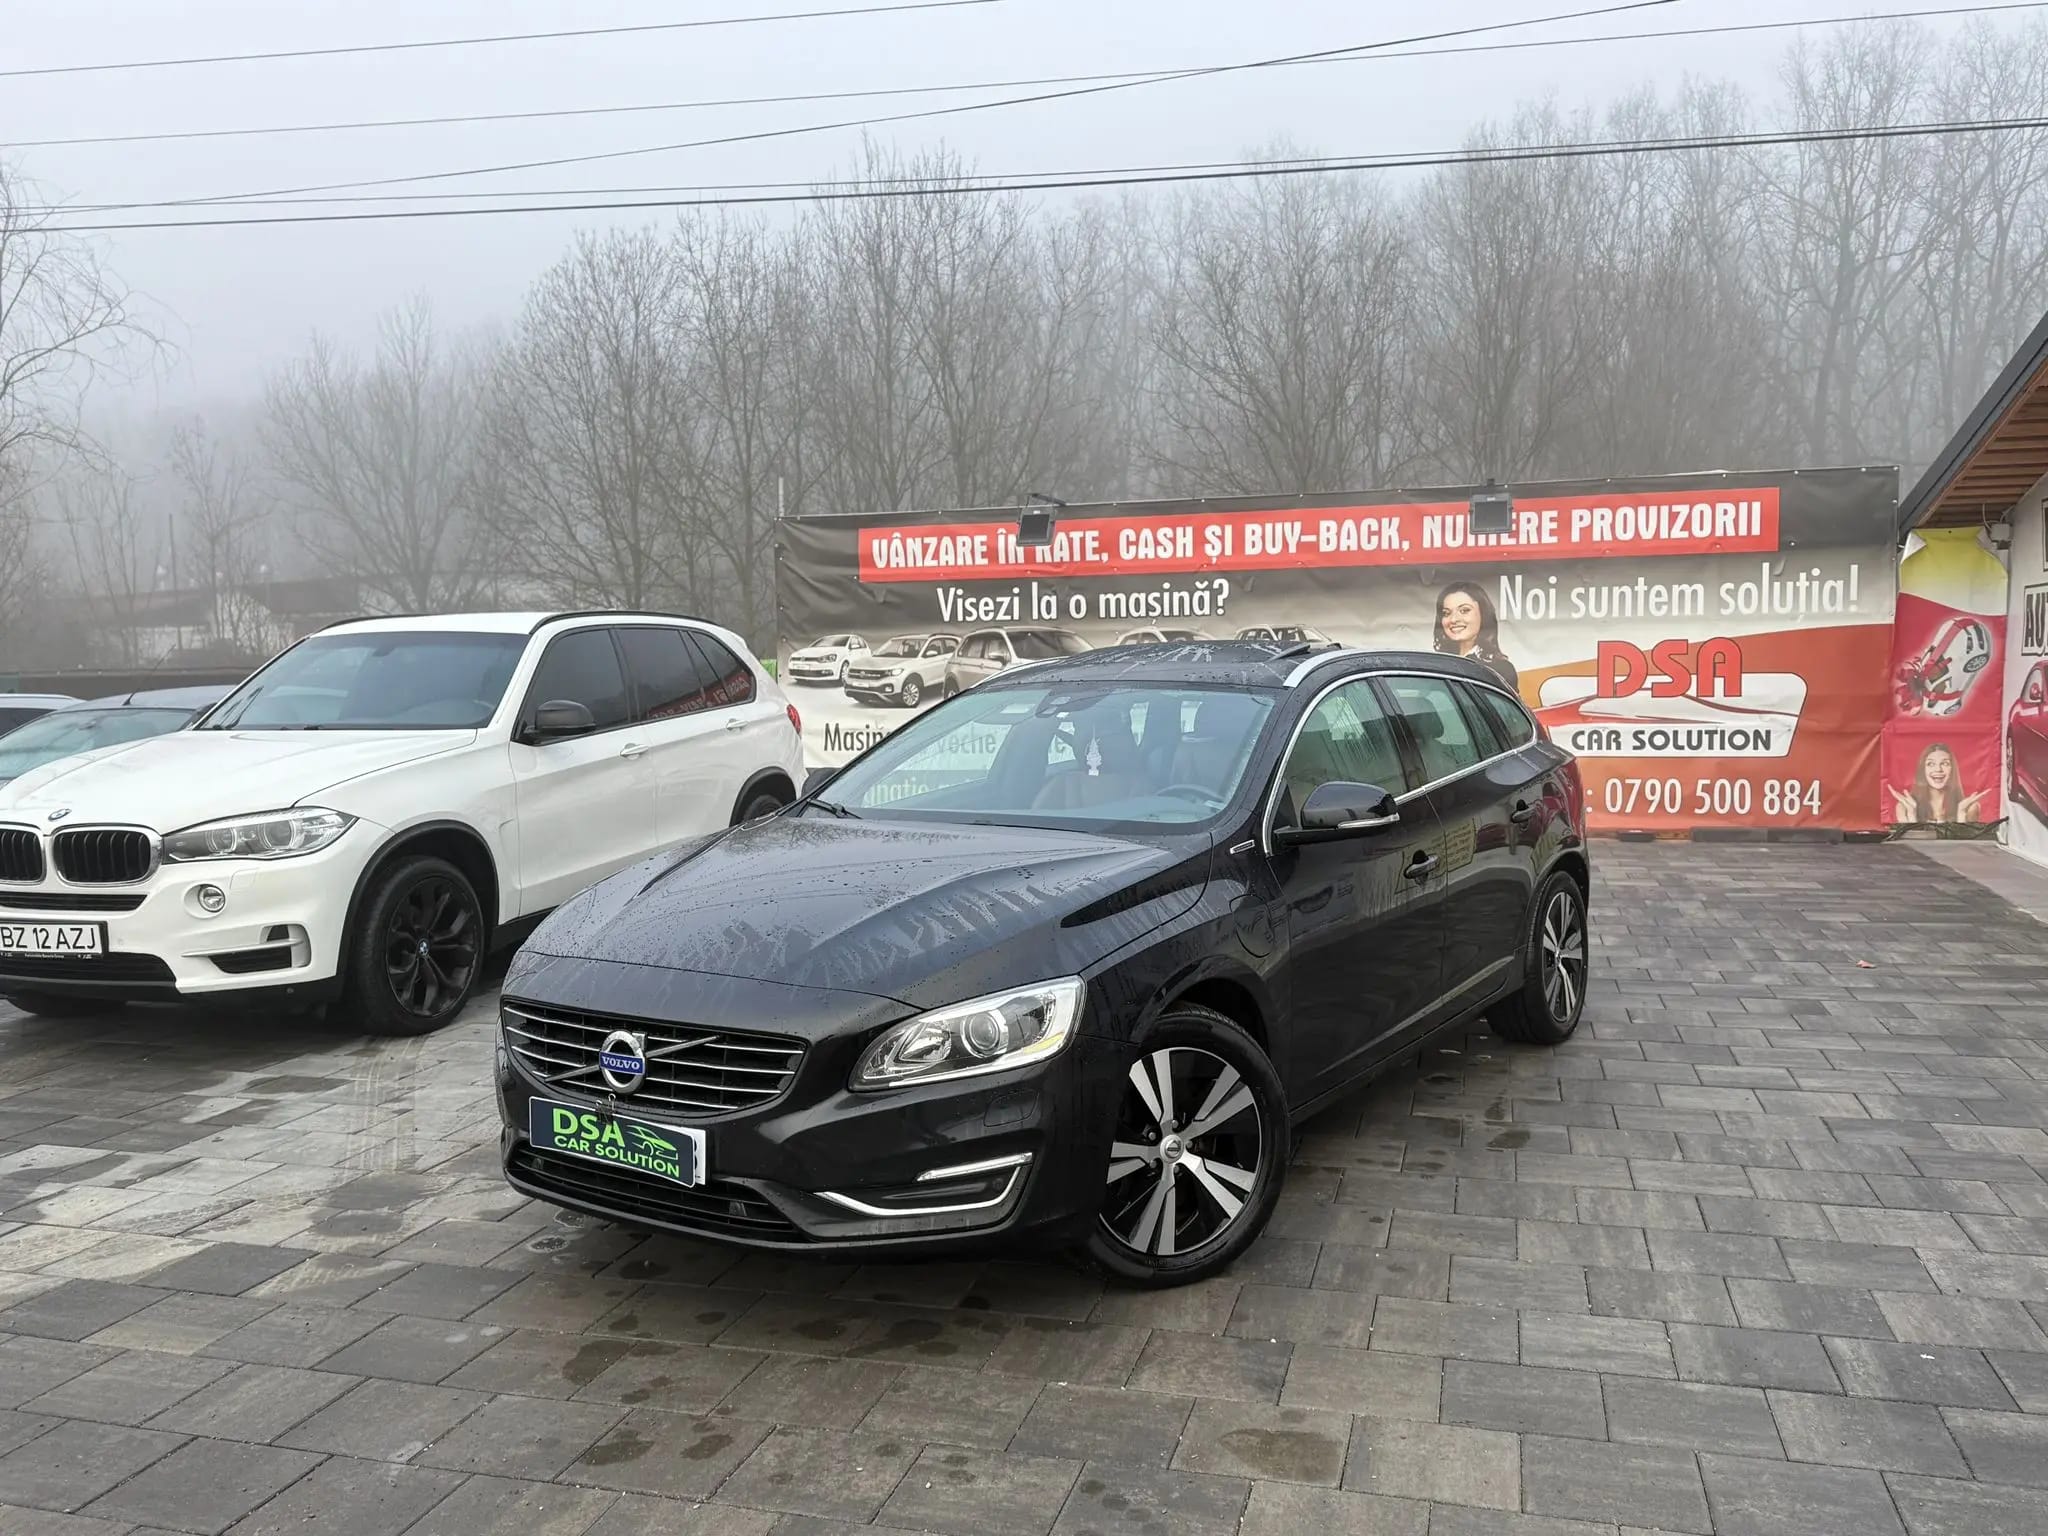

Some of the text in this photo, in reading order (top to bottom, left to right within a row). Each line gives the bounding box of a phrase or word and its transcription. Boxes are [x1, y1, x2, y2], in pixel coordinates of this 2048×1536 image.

[872, 532, 988, 569] VÂNZARE
[997, 528, 1025, 564] ÎN
[1119, 526, 1193, 560] CASH
[1204, 524, 1233, 564] ȘI
[1244, 517, 1410, 555] BUY-BACK,
[1571, 501, 1761, 543] PROVIZORII
[936, 578, 1230, 625] Visezi la o mașină?
[1499, 562, 1860, 623] Noi suntem soluția!
[1597, 637, 1743, 698] DSA
[1571, 729, 1772, 751] CAR SOLUTION
[1605, 778, 1682, 814] 0790
[1694, 778, 1752, 815] 500
[1763, 779, 1822, 816] 884
[0, 926, 96, 950] BZ 12 AZJ
[601, 1056, 640, 1070] VOLVO
[552, 1107, 626, 1148] DSA
[554, 1135, 680, 1178] CAR SOLUTION
